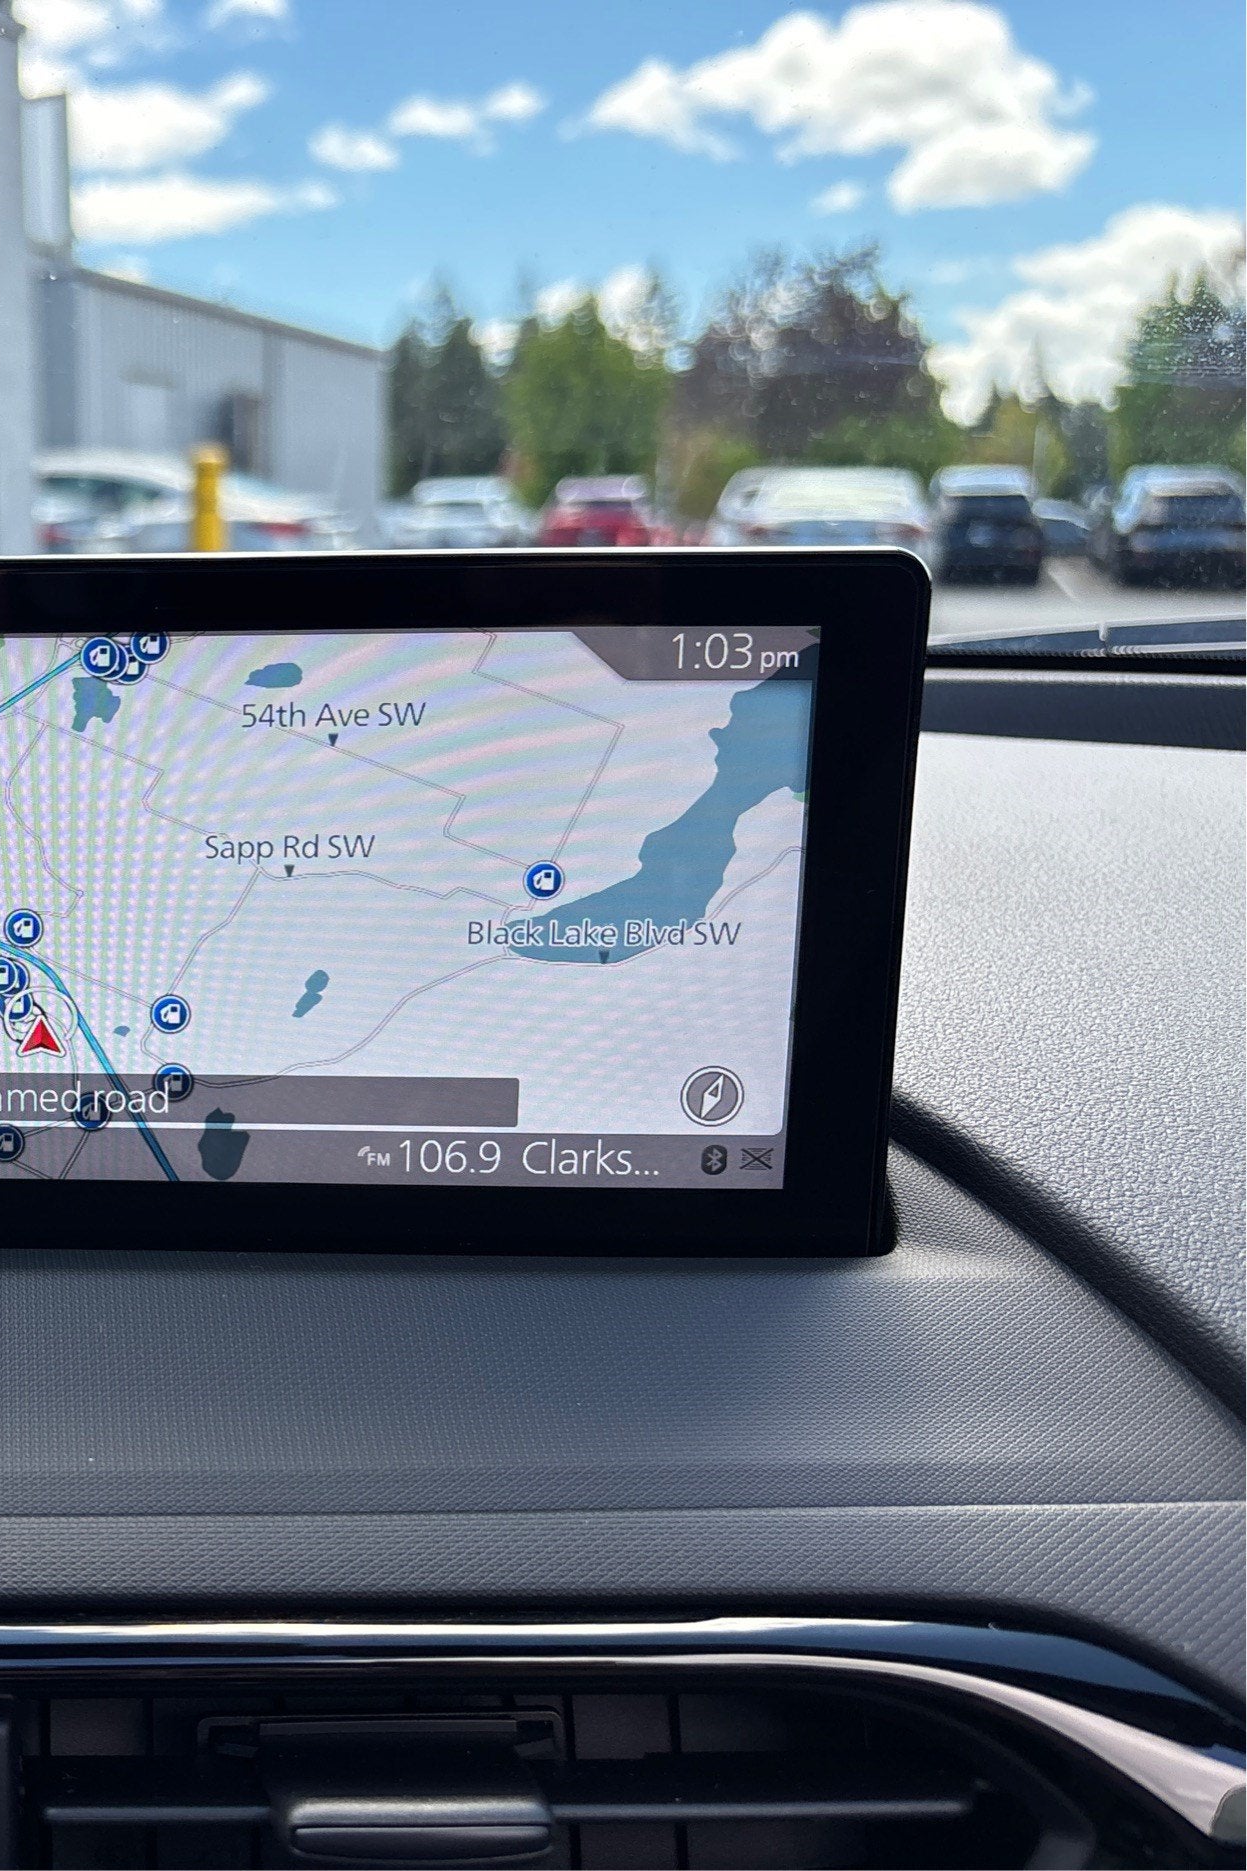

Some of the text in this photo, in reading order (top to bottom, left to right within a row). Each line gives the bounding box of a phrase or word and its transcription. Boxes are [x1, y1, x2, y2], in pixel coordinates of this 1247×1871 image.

[671, 632, 799, 673] 1:03 pm
[241, 702, 426, 728] 54th Ave SW
[205, 834, 375, 864] Sapp Rd SW
[467, 921, 741, 947] Black Lake Blvd SW
[91, 1081, 169, 1114] road
[367, 1139, 660, 1177] FM 106.9 Clarks...
